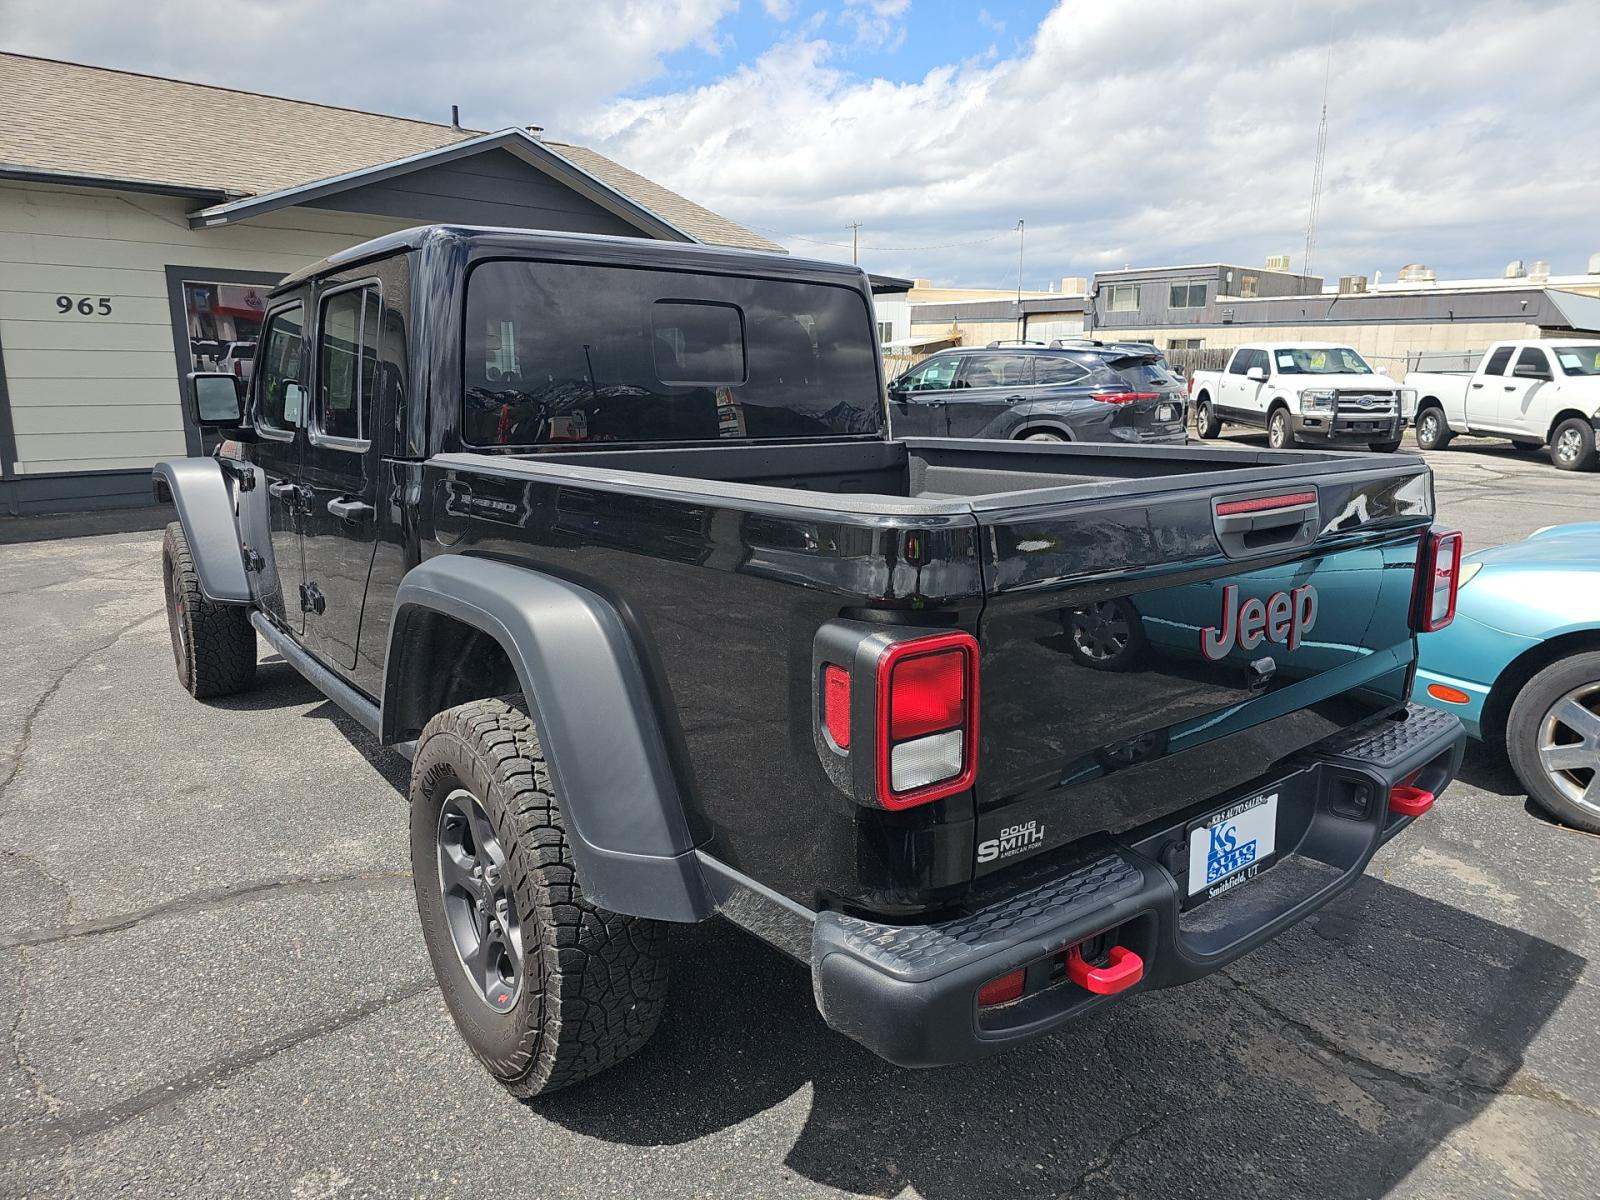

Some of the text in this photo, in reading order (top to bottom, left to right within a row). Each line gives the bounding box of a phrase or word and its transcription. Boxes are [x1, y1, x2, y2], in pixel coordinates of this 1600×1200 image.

[56, 295, 112, 315] 965
[1201, 584, 1319, 660] Jeep
[1000, 820, 1037, 837] DOUG
[977, 825, 1044, 863] SMITH
[1208, 843, 1255, 873] AUTO
[1208, 854, 1254, 882] SALES
[1248, 864, 1259, 877] UT
